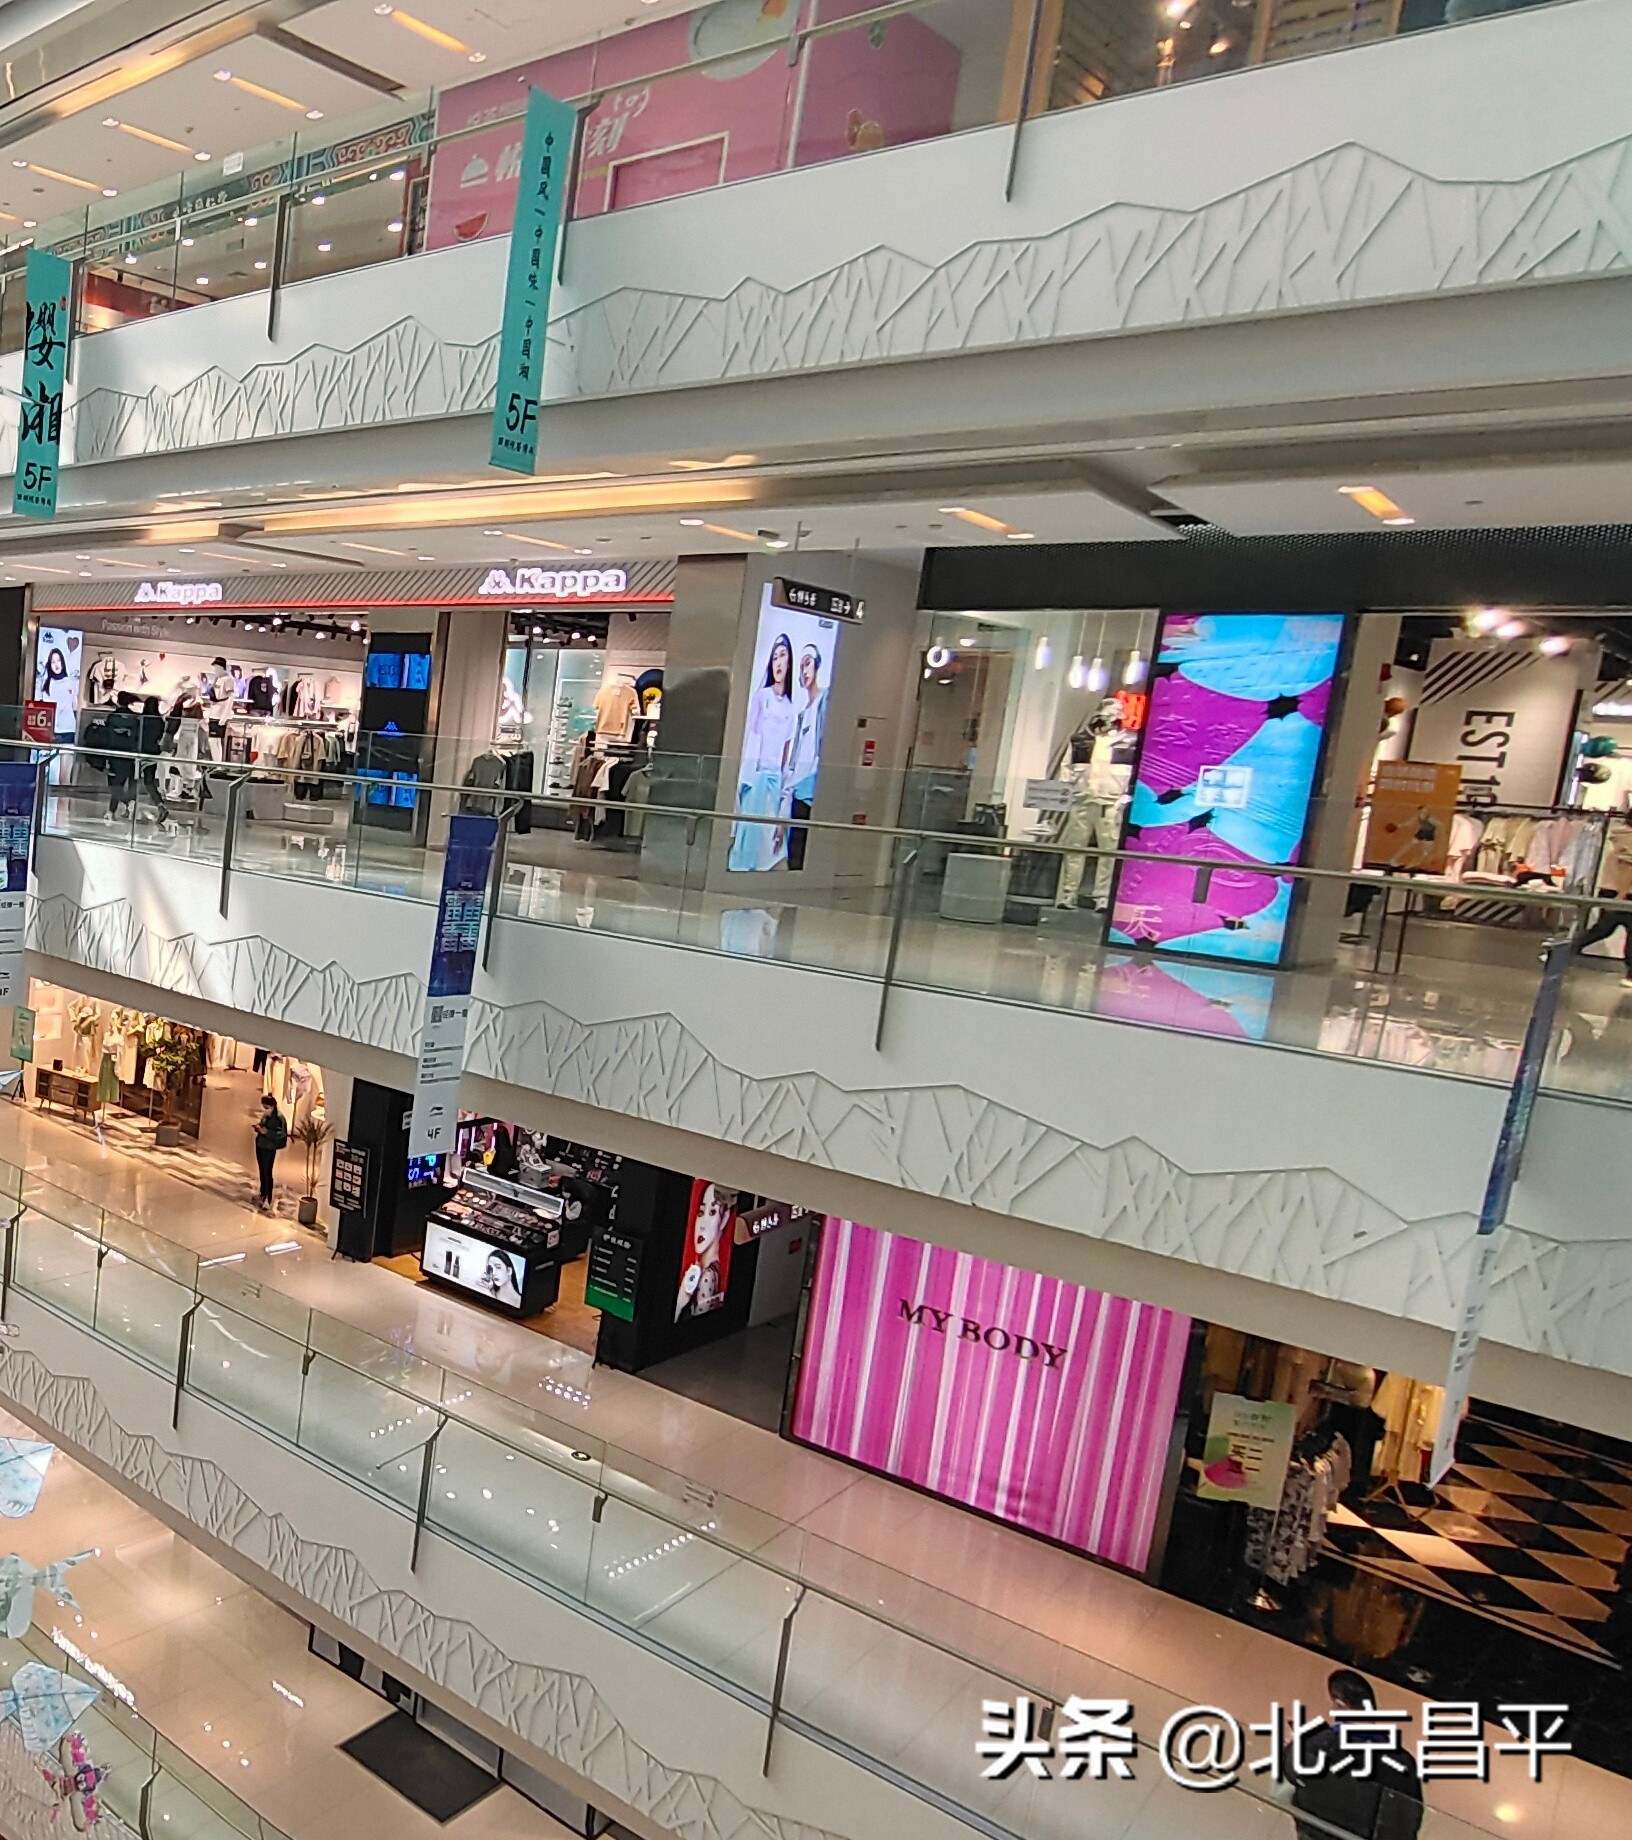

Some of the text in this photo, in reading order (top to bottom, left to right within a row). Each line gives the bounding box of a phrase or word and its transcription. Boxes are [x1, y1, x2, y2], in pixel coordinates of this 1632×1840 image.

[505, 393, 538, 434] 5F
[23, 462, 52, 492] 5F
[157, 581, 222, 605] Kappa
[515, 567, 626, 598] Kappa
[1456, 710, 1515, 768] EST
[427, 1128, 442, 1139] 4F
[898, 1298, 1069, 1369] MY BODY
